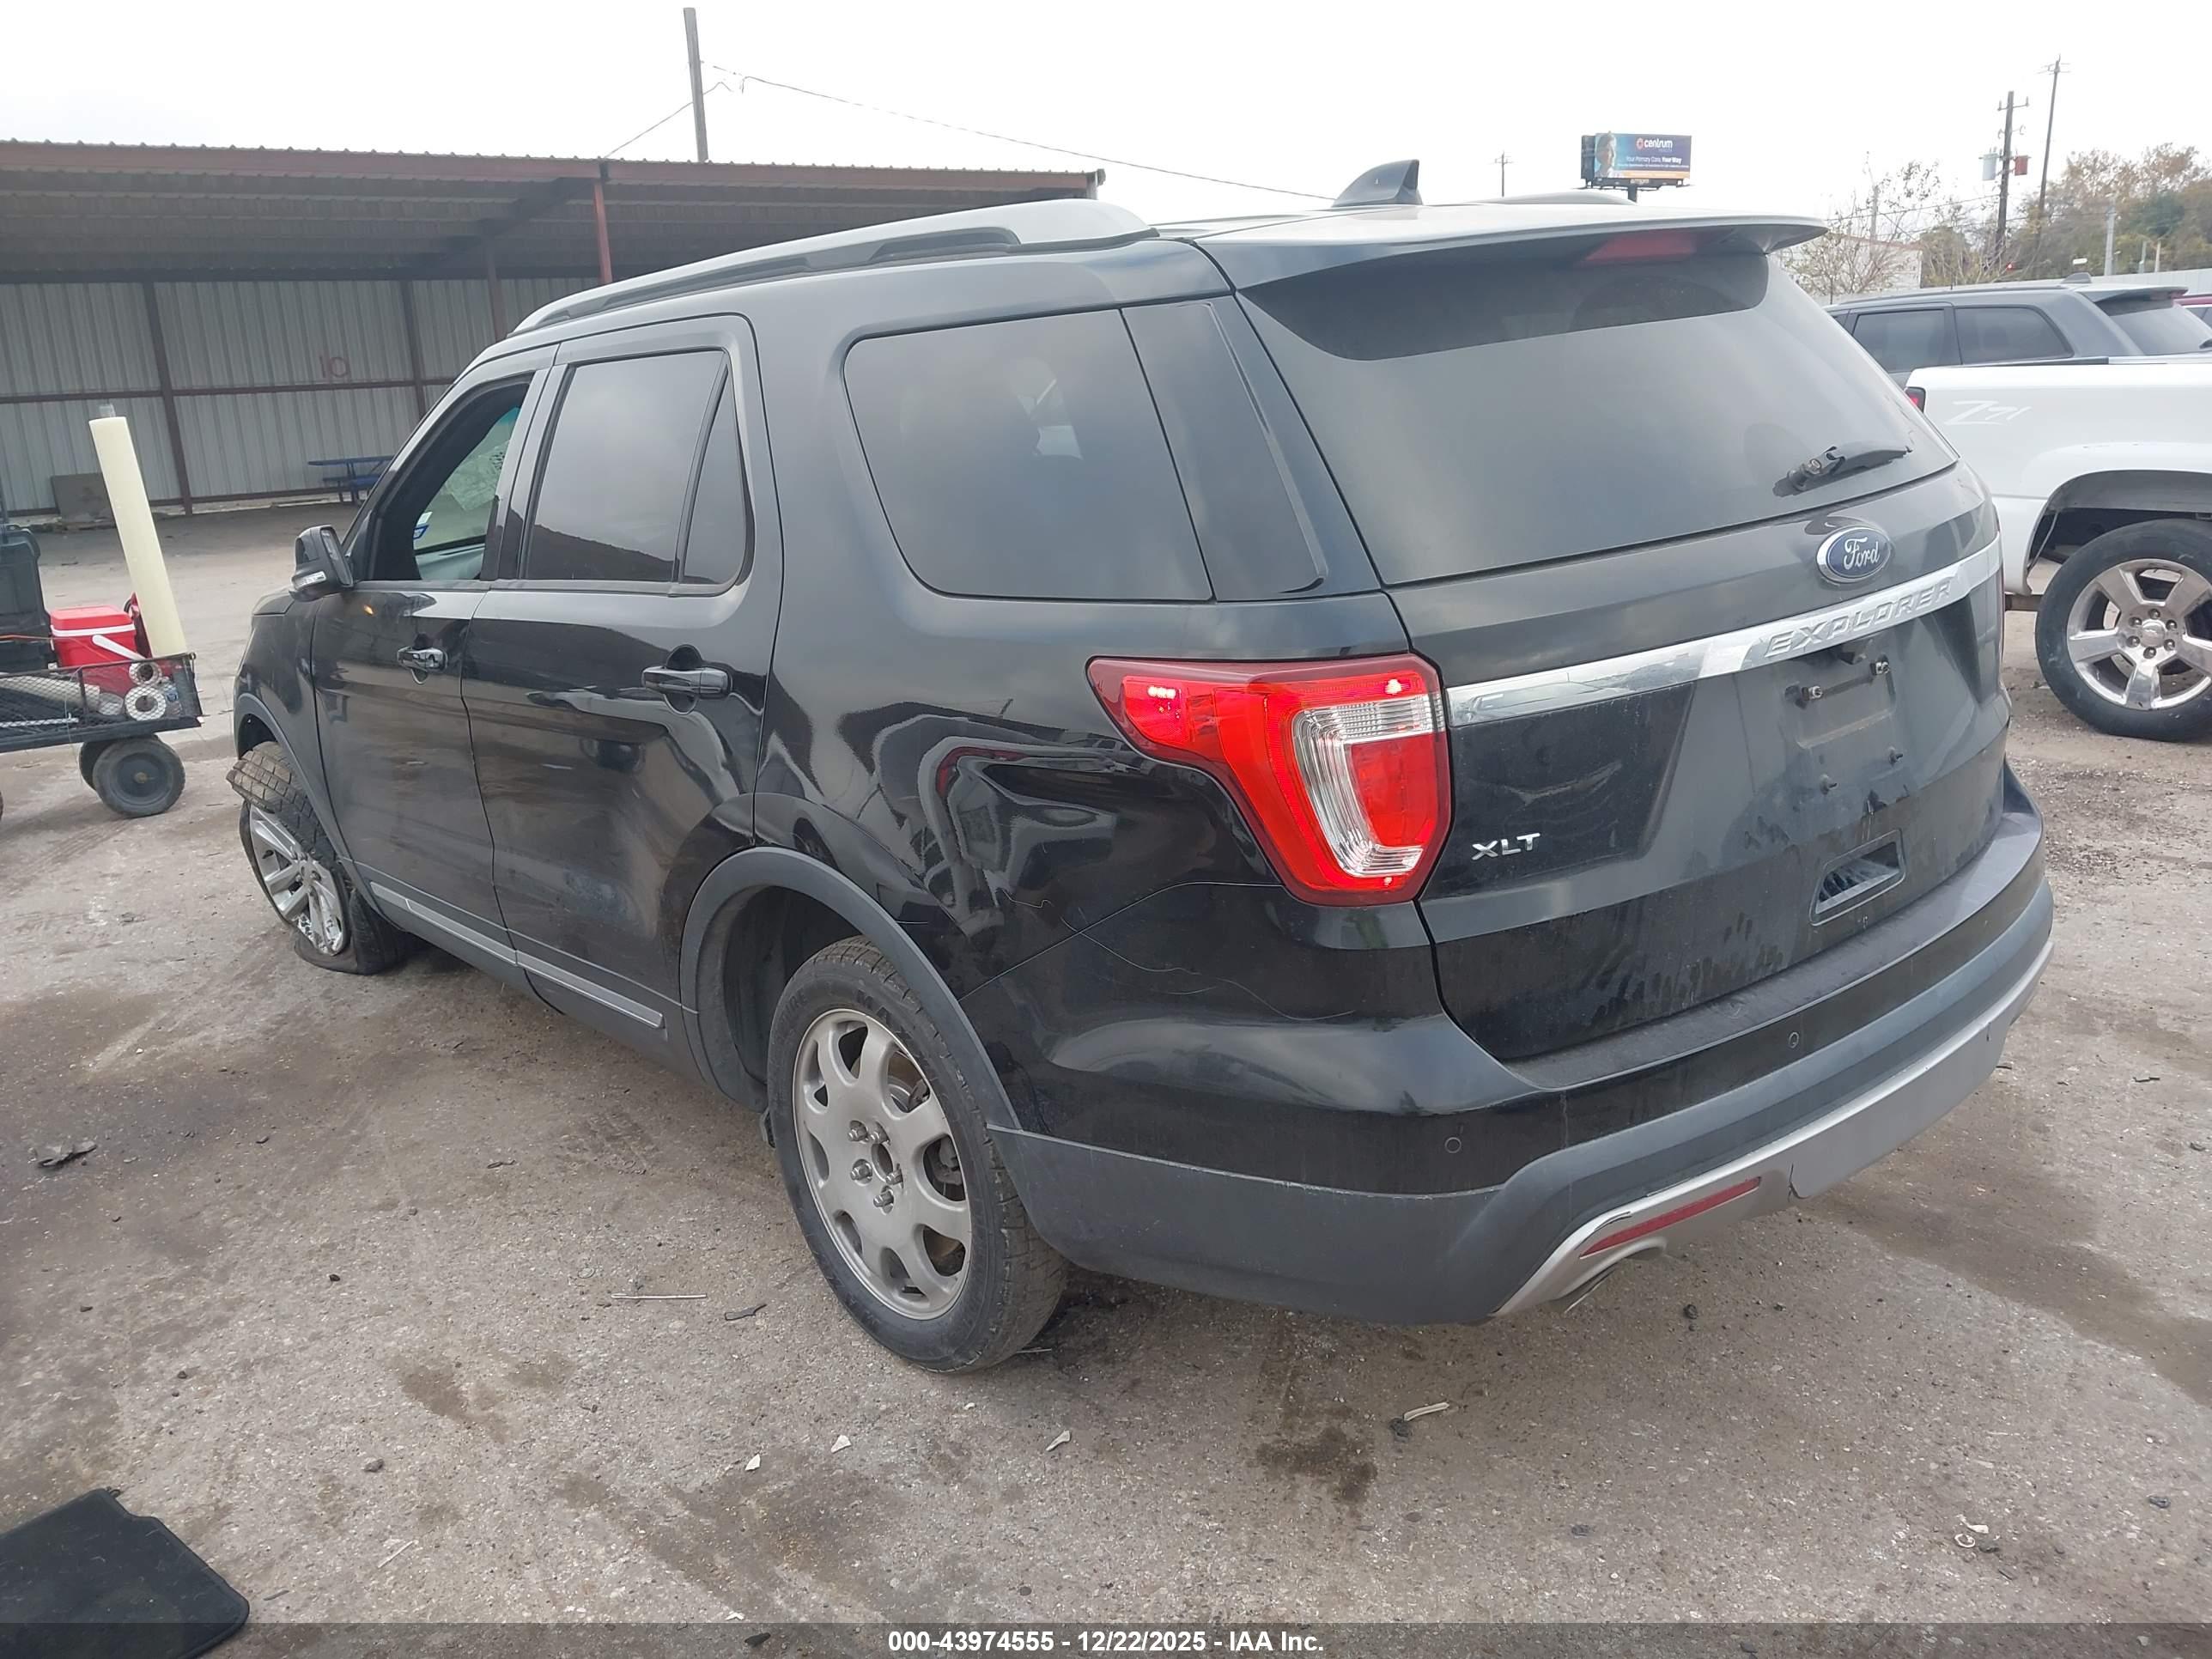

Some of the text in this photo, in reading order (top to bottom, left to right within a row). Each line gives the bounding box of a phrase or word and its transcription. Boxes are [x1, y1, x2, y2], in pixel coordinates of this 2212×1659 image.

[1644, 138, 1673, 149] centrum
[1843, 536, 1881, 570] Ford
[1764, 580, 1954, 659] EXPLORER
[1471, 832, 1541, 860] XLT
